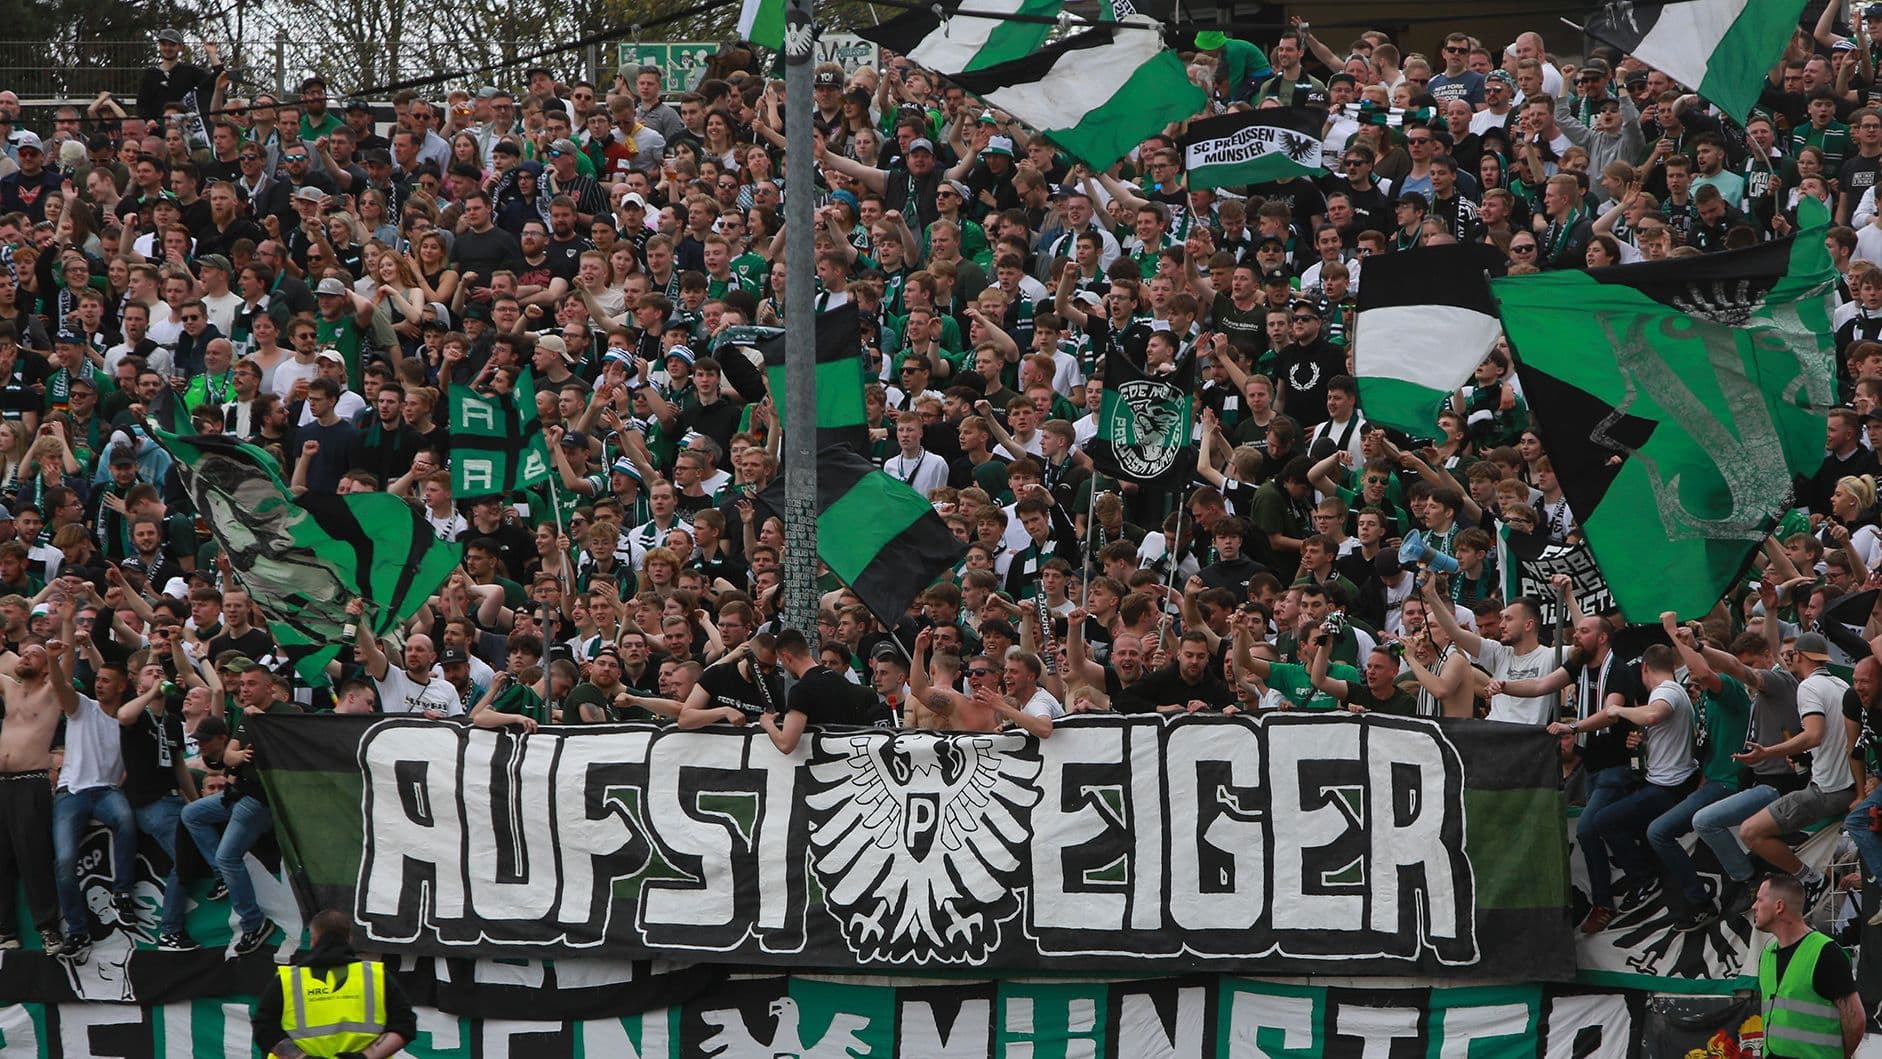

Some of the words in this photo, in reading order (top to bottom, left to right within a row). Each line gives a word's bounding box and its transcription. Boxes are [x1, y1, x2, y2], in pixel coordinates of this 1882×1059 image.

[1193, 142, 1210, 155] SC
[1214, 128, 1275, 150] PREUSSEN
[1114, 416, 1150, 474] PREUSSEN
[307, 987, 329, 996] HRC
